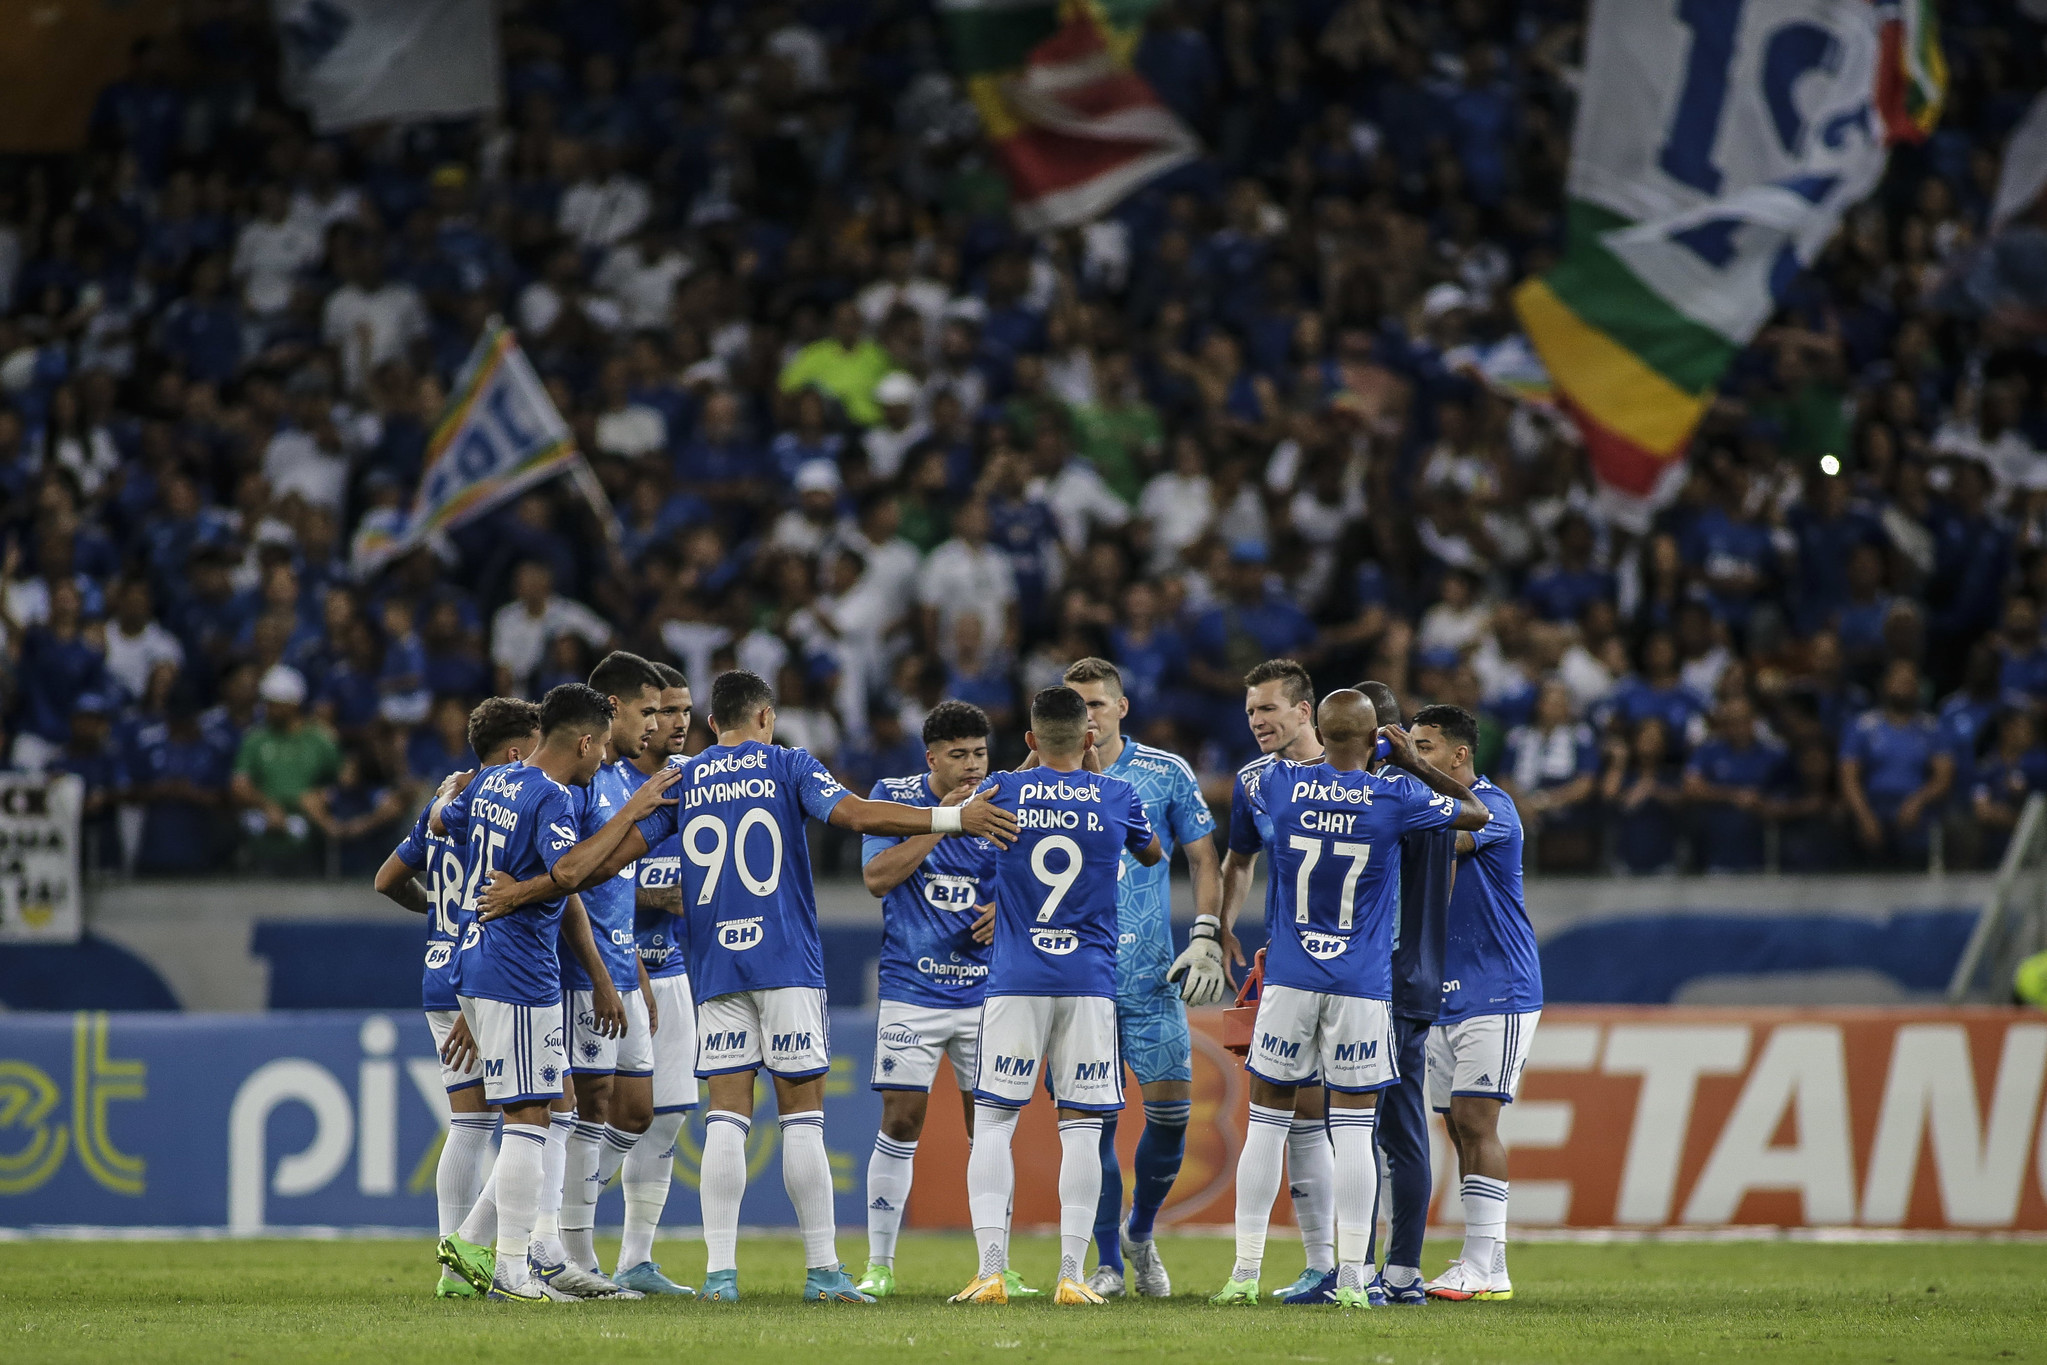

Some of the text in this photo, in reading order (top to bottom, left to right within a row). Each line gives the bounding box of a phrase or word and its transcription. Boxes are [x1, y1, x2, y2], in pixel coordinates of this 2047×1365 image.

[694, 750, 768, 785] pixbet
[685, 779, 776, 809] LUVANNOR
[1019, 780, 1102, 805] pixbet
[1291, 779, 1374, 806] pixbet
[1017, 809, 1104, 832] BRUNO R.
[1300, 810, 1357, 835] CHAY
[682, 807, 783, 906] 90
[645, 867, 681, 885] BH
[1030, 834, 1083, 923] 9
[1289, 834, 1371, 930] 77
[426, 845, 465, 938] 48
[932, 885, 970, 904] BH
[716, 915, 764, 928] SUPERMERCADOS
[725, 926, 757, 945] BH
[1038, 936, 1073, 950] BH
[1306, 939, 1341, 953] BH
[428, 949, 449, 963] BH
[917, 957, 989, 979] Champion
[934, 978, 974, 986] WATCH
[879, 1026, 922, 1046] Saudali
[1432, 1023, 2047, 1226] ETAN
